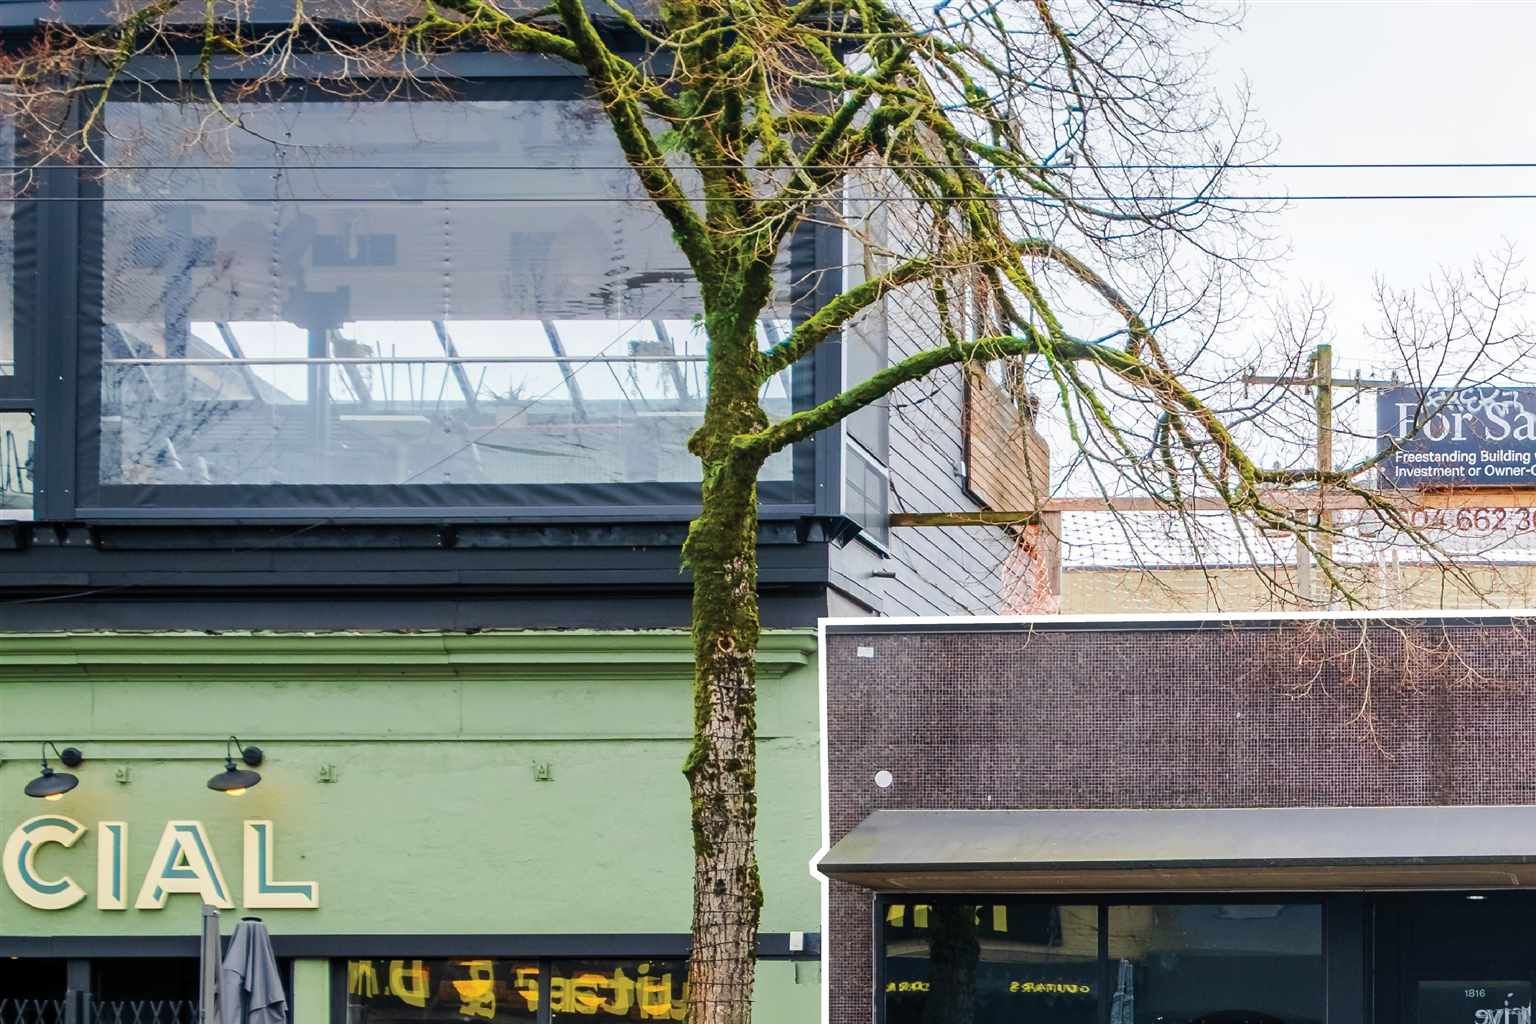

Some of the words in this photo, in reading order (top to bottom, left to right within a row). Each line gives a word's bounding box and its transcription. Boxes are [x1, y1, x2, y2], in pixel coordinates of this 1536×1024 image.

[1395, 402, 1474, 441] For
[1395, 450, 1477, 464] Freestanding
[1480, 450, 1531, 464] Building
[1395, 466, 1466, 477] Investment
[1468, 467, 1482, 477] or
[1456, 508, 1507, 532] 662
[3, 815, 319, 909] CIAL
[1464, 988, 1486, 998] 1816
